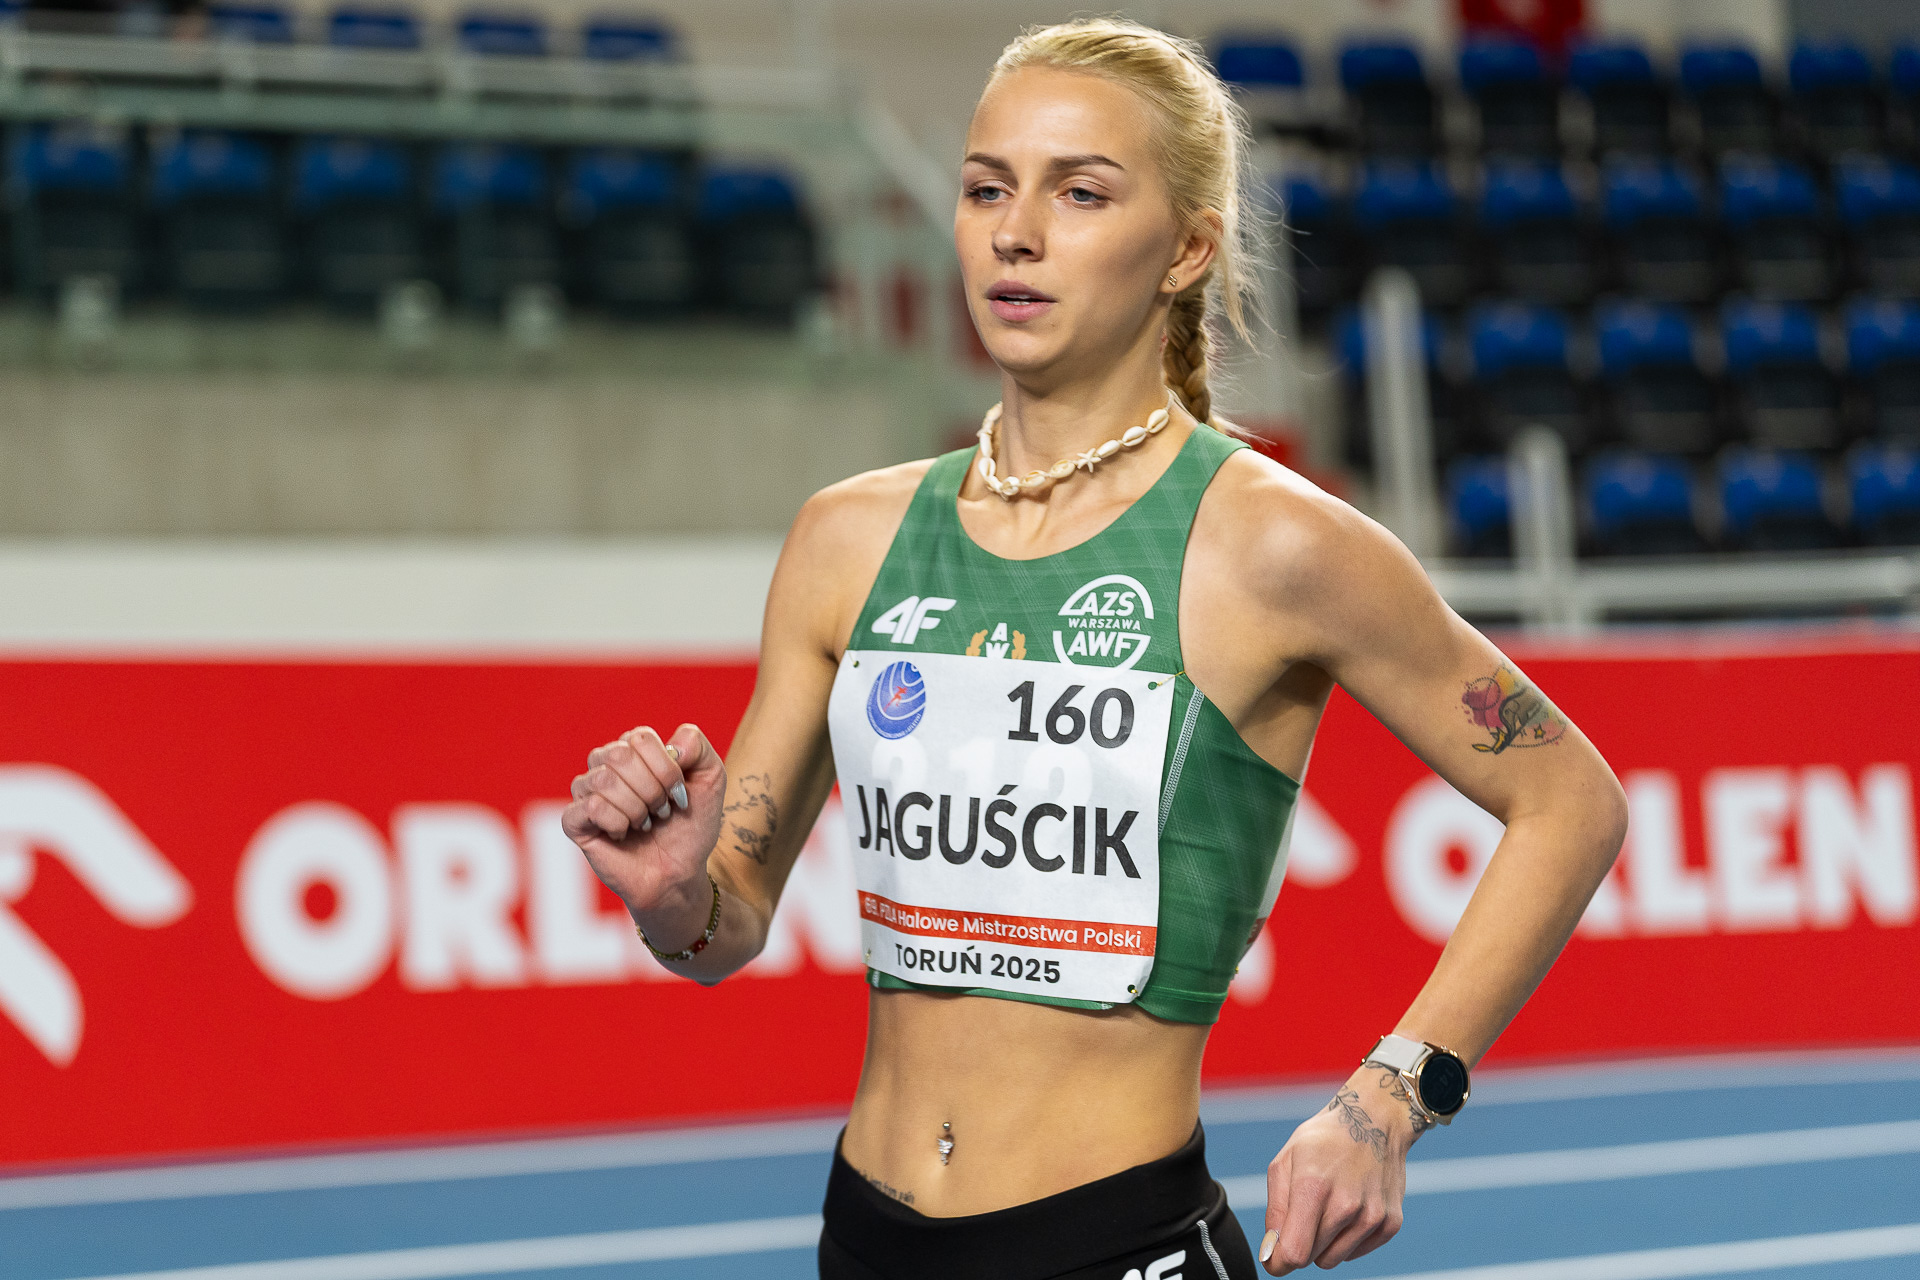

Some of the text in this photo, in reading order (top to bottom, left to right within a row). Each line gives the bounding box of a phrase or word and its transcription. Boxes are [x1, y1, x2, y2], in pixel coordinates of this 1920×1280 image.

[871, 595, 957, 645] 4F
[1067, 617, 1142, 631] WARSZAWA
[1079, 591, 1137, 617] AZS
[1066, 630, 1151, 658] AWF
[1006, 680, 1135, 749] 160
[856, 783, 1142, 880] JAGUŚCIK
[1384, 764, 1917, 945] OLEN
[235, 796, 866, 1000] ORLN
[898, 909, 960, 933] Halowe
[962, 916, 1078, 944] Mistrzostwa
[1083, 927, 1143, 949] Polski
[894, 942, 1061, 984] TORUŃ 2025
